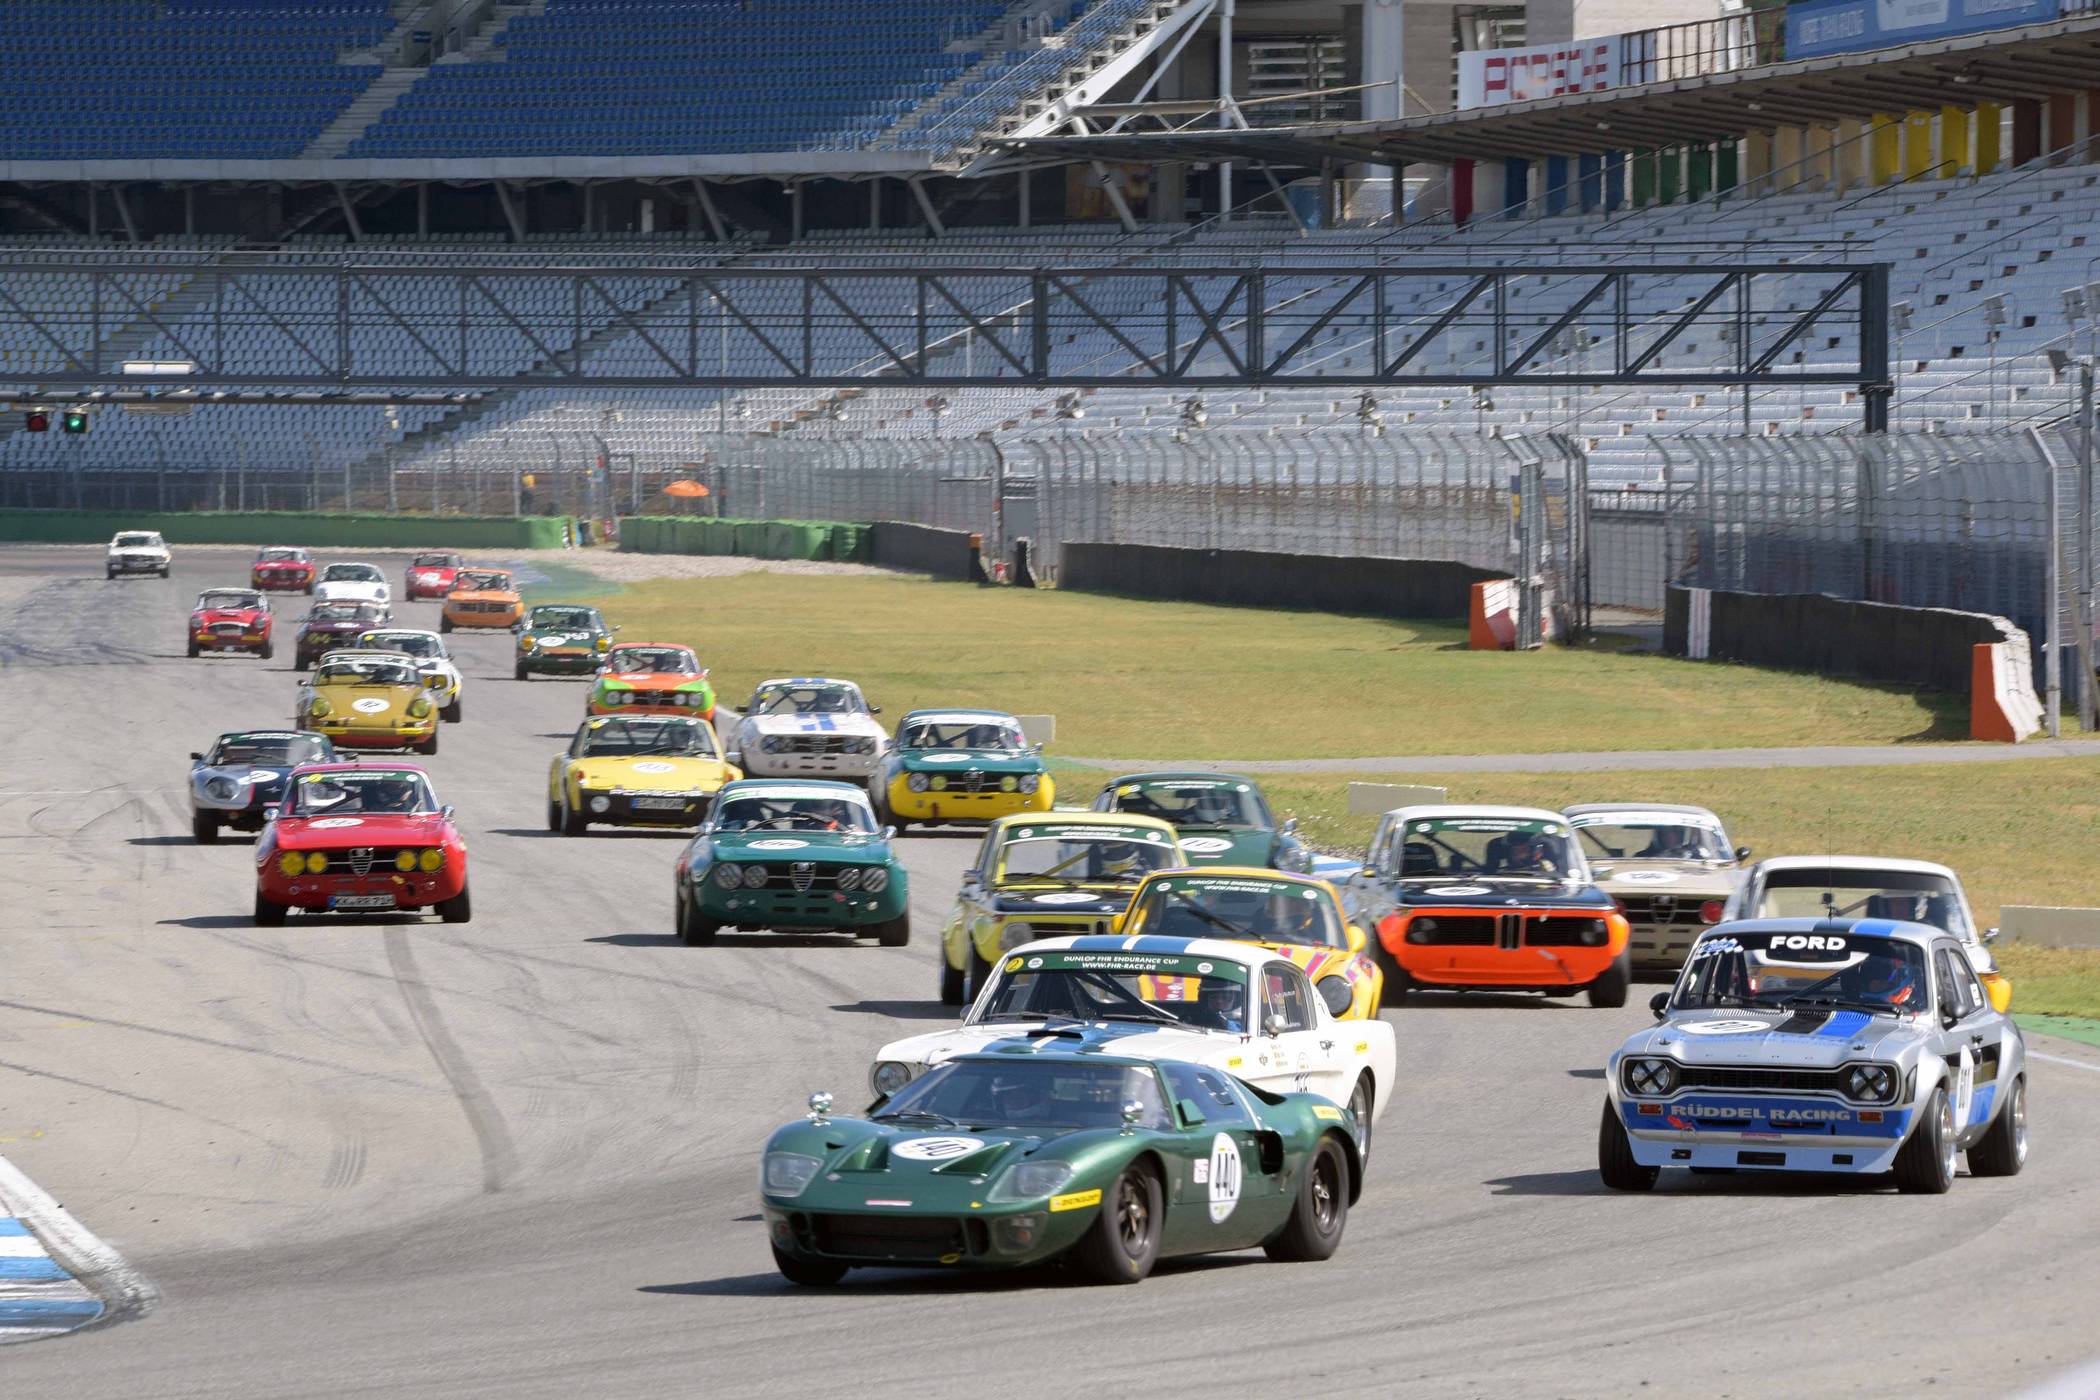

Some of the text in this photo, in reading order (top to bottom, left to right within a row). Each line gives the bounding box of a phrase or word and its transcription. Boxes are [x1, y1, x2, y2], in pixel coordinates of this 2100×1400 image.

[1484, 45, 1608, 103] PORSCHE
[1769, 936, 1847, 950] FORD
[1082, 962, 1156, 970] WWW.FHR-RACE.DE
[1113, 956, 1161, 964] ENDURANCE
[1670, 1104, 1850, 1121] RÜDDEL RACING
[1214, 1152, 1236, 1199] 440
